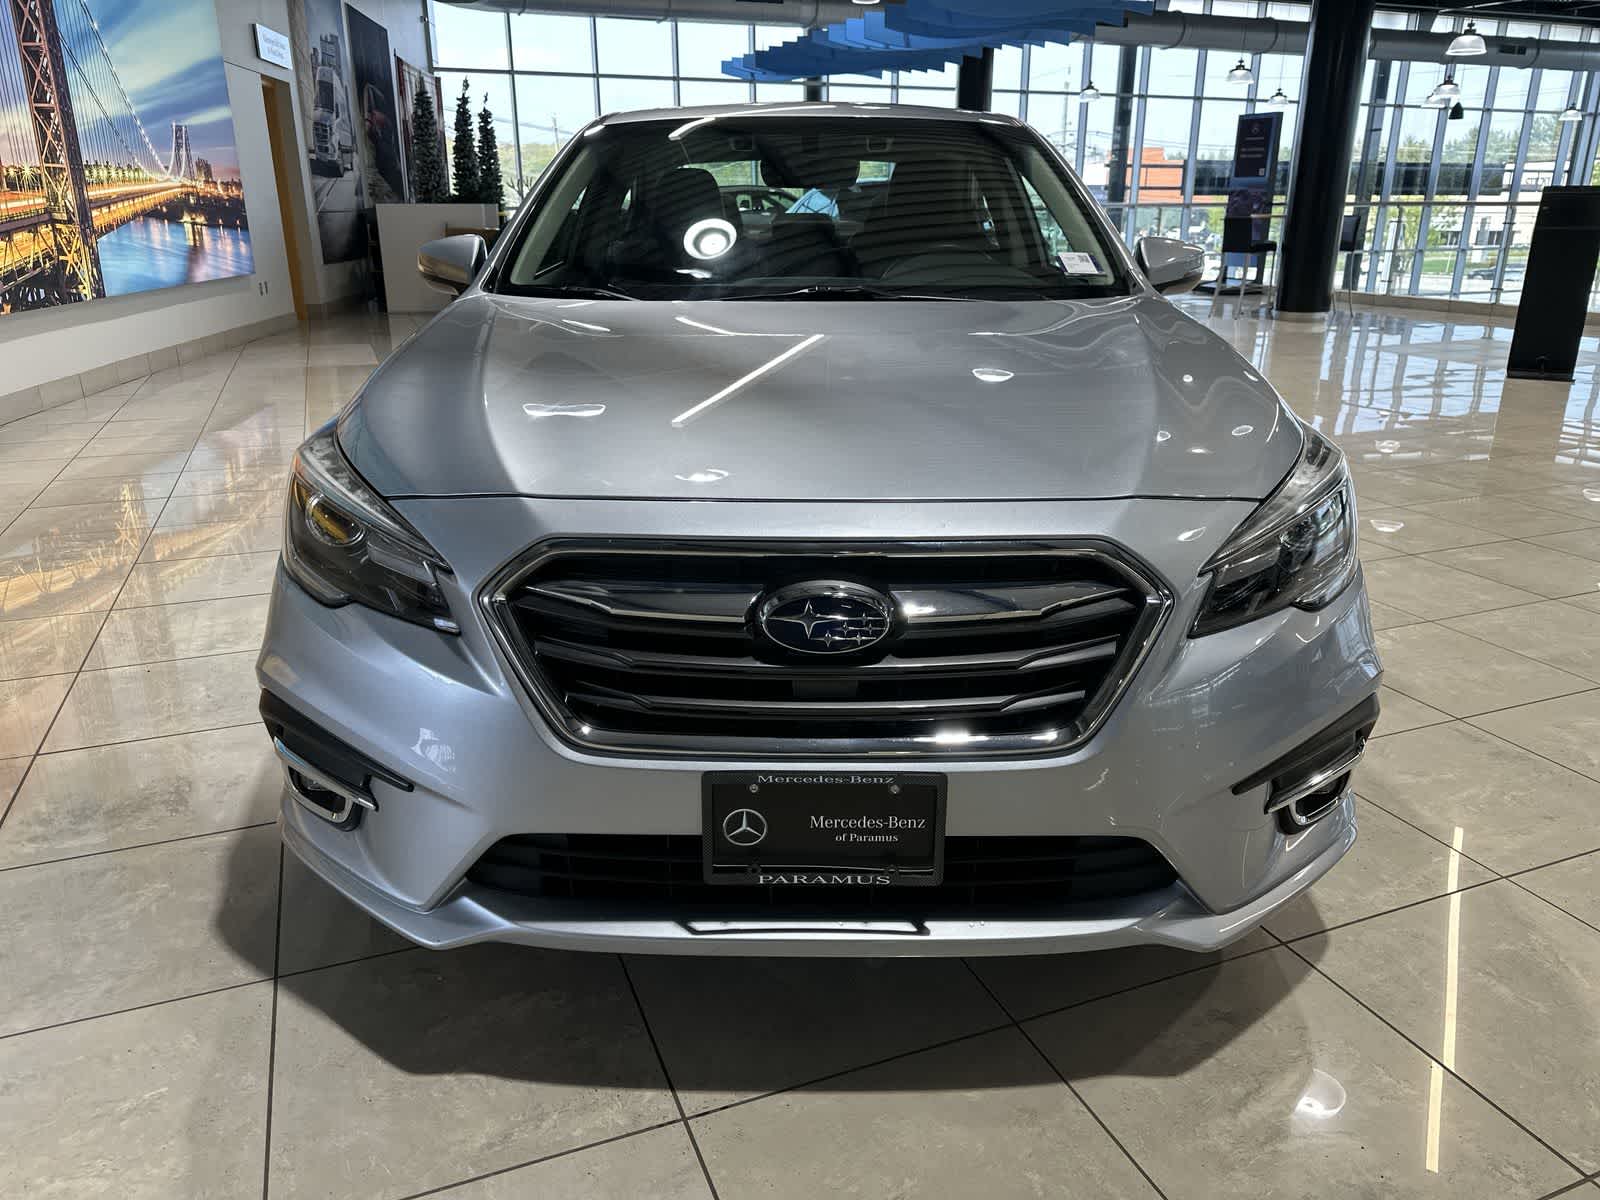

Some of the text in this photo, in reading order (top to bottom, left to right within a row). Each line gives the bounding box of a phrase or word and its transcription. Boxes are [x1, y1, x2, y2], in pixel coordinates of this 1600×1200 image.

[757, 775, 896, 784] Mercedes-Benz
[809, 815, 926, 829] Mercedes-Benz
[835, 833, 899, 843] of Paramus
[758, 875, 891, 885] PARAMUS
